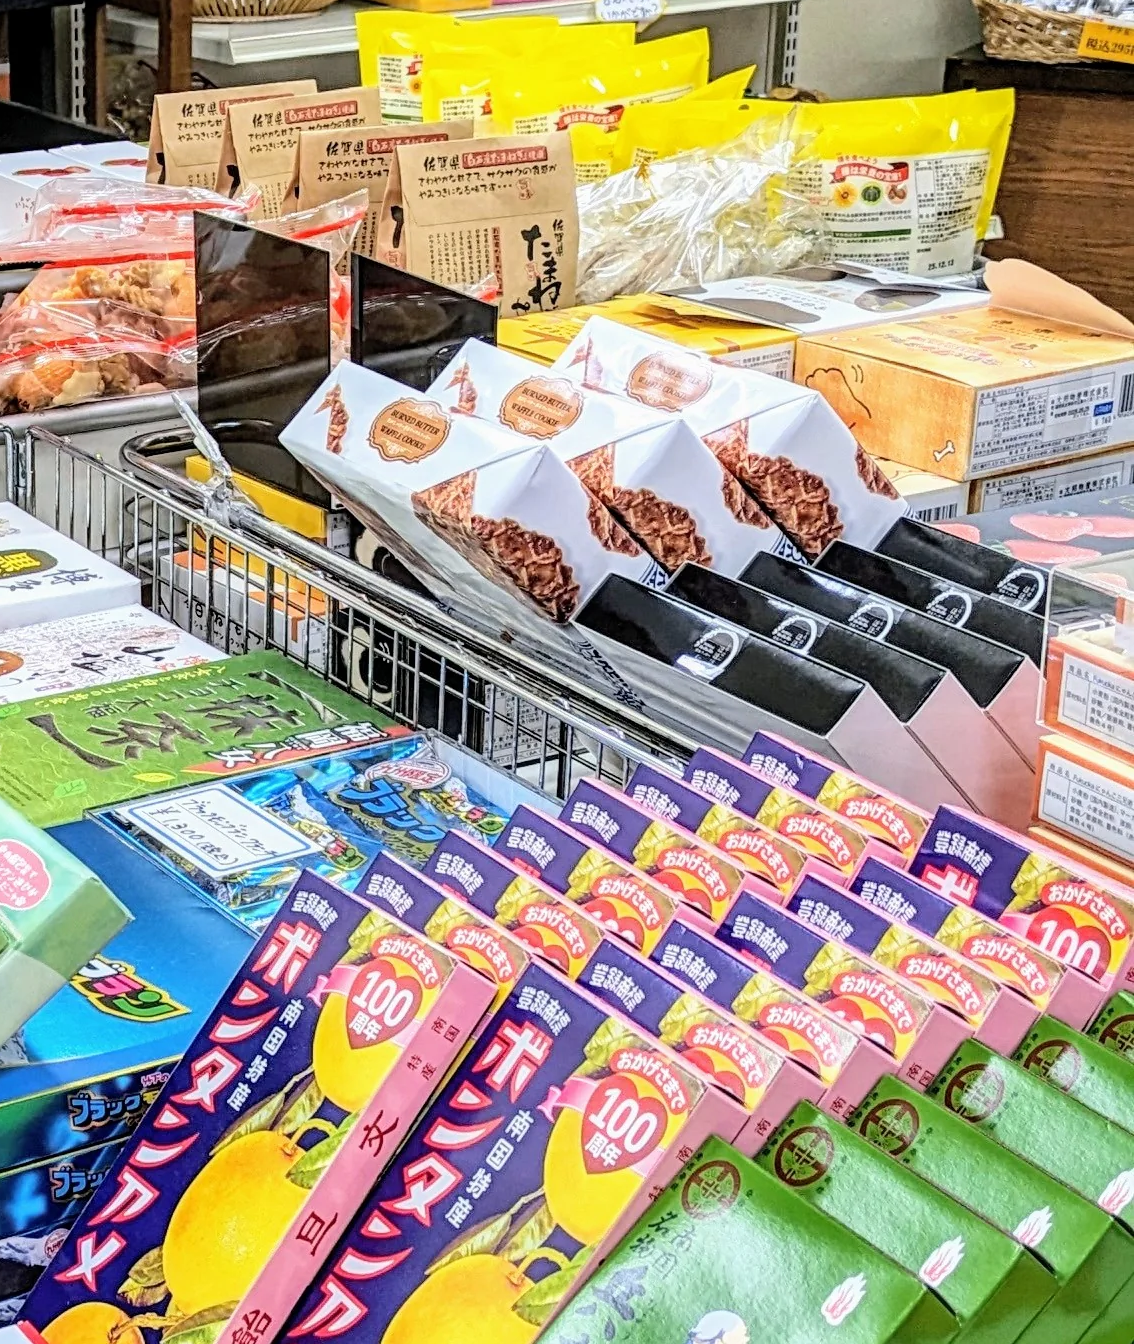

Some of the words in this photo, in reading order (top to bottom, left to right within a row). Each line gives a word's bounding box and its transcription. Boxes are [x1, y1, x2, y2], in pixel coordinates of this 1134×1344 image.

[1086, 38, 1134, 56] 税込295
[182, 102, 216, 119] 佐賀県
[252, 113, 284, 129] 佐賀県
[326, 140, 364, 157] 佐賀県
[423, 154, 461, 172] 佐賀県
[552, 219, 565, 258] 佐賀県
[511, 402, 536, 420] WAFFLE
[535, 412, 560, 429] COOKIE
[522, 386, 549, 404] BURNED
[546, 395, 572, 413] BUTTER
[379, 424, 403, 444] WAFFLE
[403, 434, 428, 451] COOKIE
[390, 408, 414, 427] BURNED
[413, 418, 441, 437] BUTTER
[88, 693, 309, 757] 抹茶
[341, 780, 445, 840] ブラック
[839, 797, 913, 853] おかげさまで
[591, 875, 662, 926] おかげさまで
[1040, 880, 1129, 940] おかげさまで
[373, 934, 438, 989] おかげさまで
[1037, 917, 1100, 968] 100
[351, 974, 407, 1028] 100
[832, 972, 916, 1034] おかげさまで
[351, 1015, 383, 1042] 周年
[430, 1014, 462, 1043] 南国
[407, 1054, 438, 1085] 特産
[684, 1023, 766, 1091] おかげさまで
[611, 1047, 687, 1114] おかげさまで
[55, 918, 323, 1292] ボンタンアメ
[71, 1091, 141, 1130] ブラック
[594, 1087, 660, 1151] 100
[583, 1131, 620, 1167] 周年
